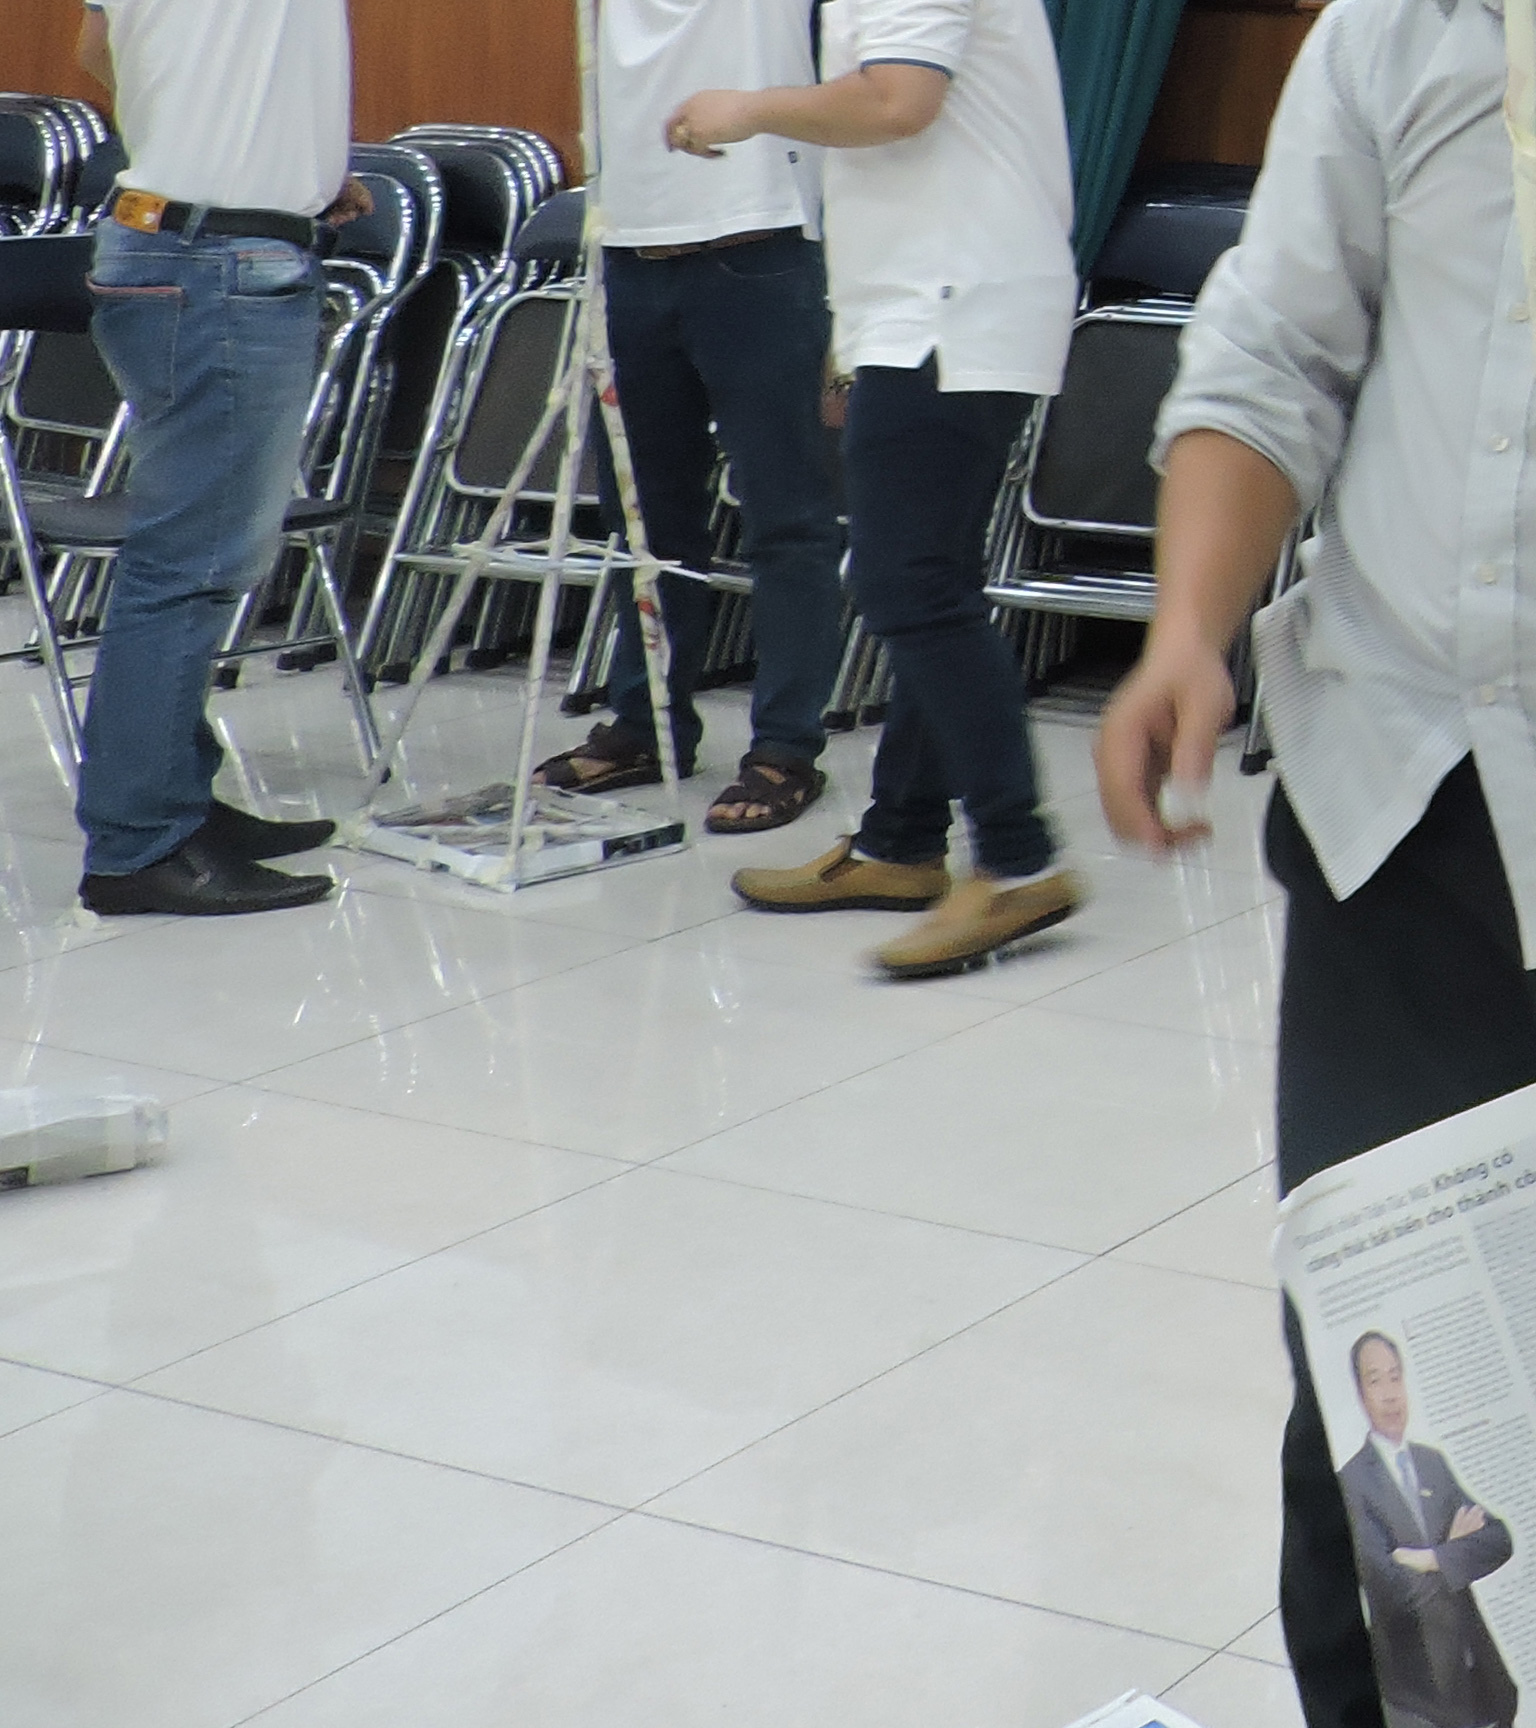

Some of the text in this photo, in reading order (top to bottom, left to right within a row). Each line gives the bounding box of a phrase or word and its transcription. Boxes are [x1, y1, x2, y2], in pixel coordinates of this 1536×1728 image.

[1432, 1160, 1489, 1193] Không
[1492, 1148, 1513, 1169] có
[1456, 1179, 1512, 1213] thành
